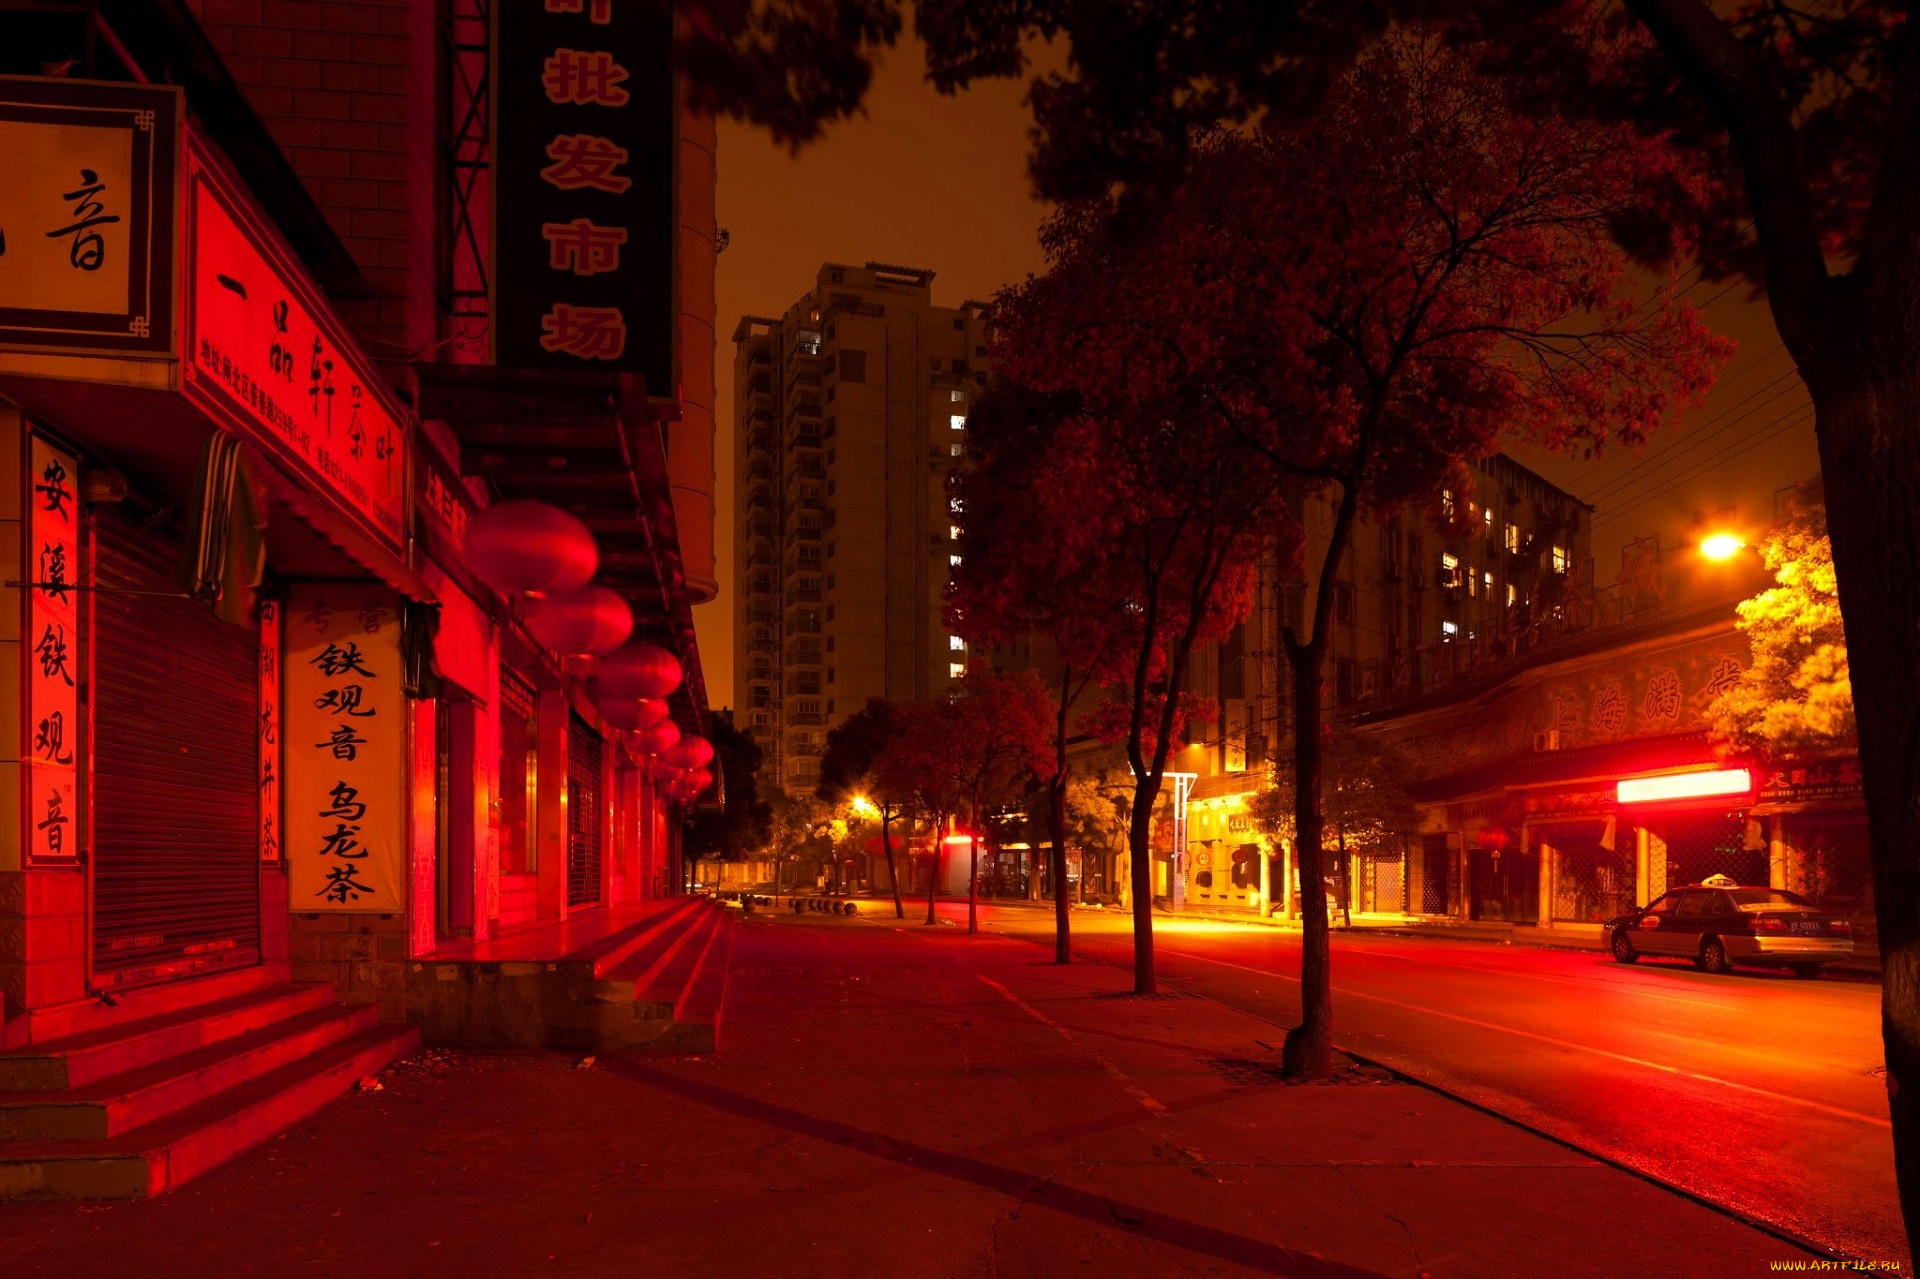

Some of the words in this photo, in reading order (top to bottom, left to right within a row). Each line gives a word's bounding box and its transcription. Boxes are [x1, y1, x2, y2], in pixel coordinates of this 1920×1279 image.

[0, 169, 120, 271] 音
[541, 0, 632, 360] 批发市场
[35, 457, 74, 855] 安溪铁观音
